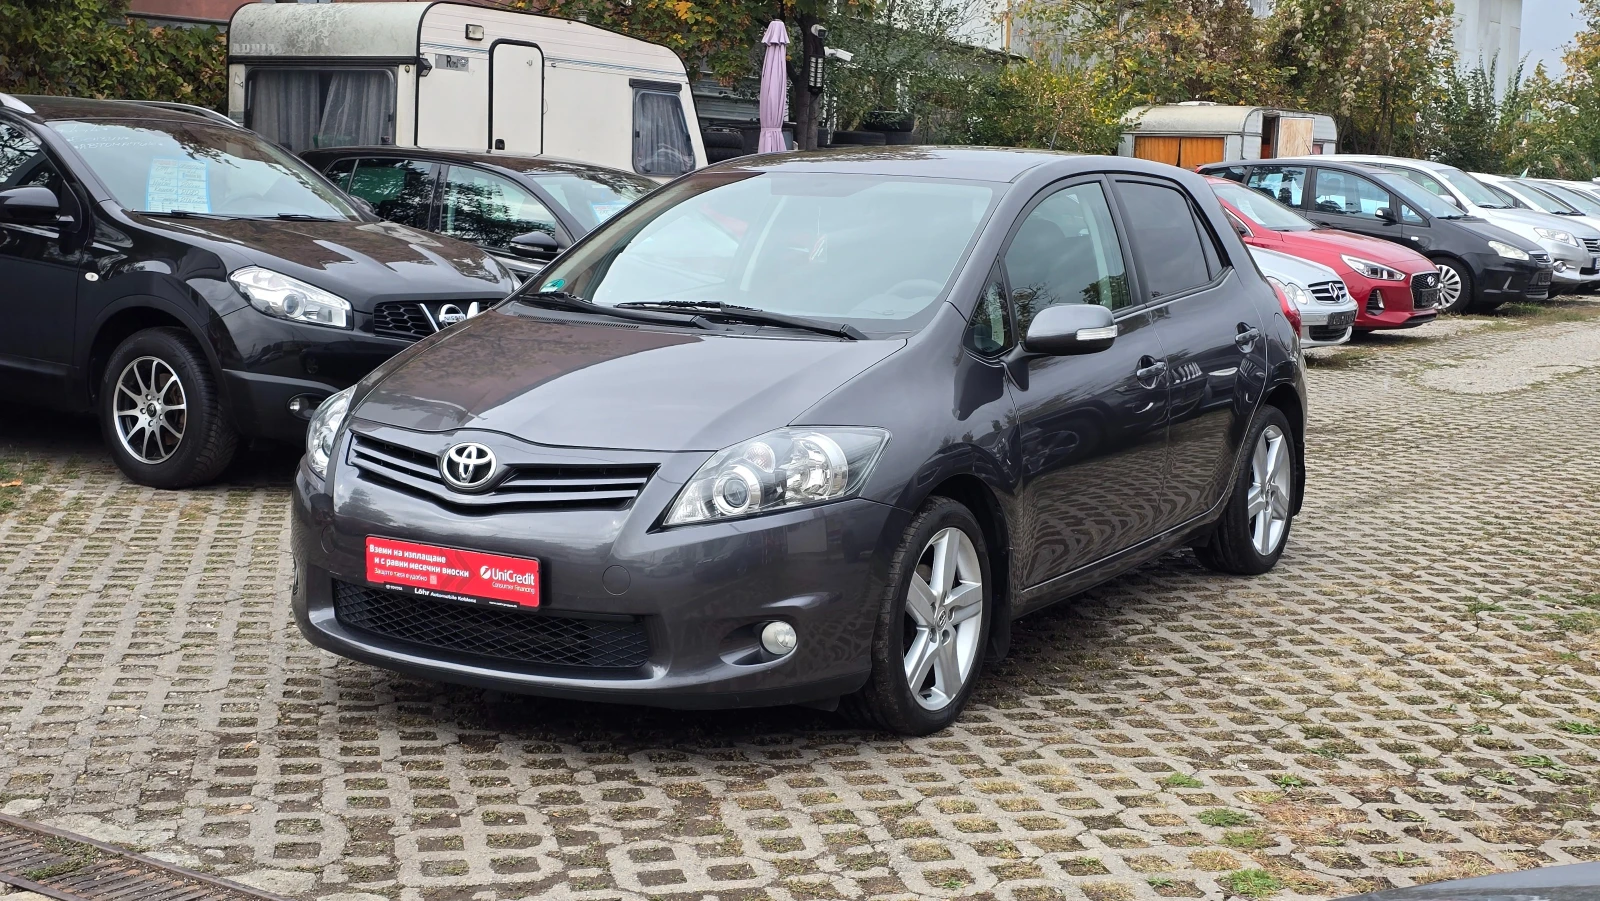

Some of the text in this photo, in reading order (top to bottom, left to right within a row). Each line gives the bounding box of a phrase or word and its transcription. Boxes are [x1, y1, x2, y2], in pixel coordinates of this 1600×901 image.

[369, 544, 446, 563] Вземи на изплащане
[386, 559, 409, 568] равни
[409, 563, 440, 573] месечни
[442, 568, 469, 577] вноски
[491, 567, 535, 586] UniCredit
[414, 587, 430, 597] Löhr
[491, 581, 535, 595] Consumer Financing
